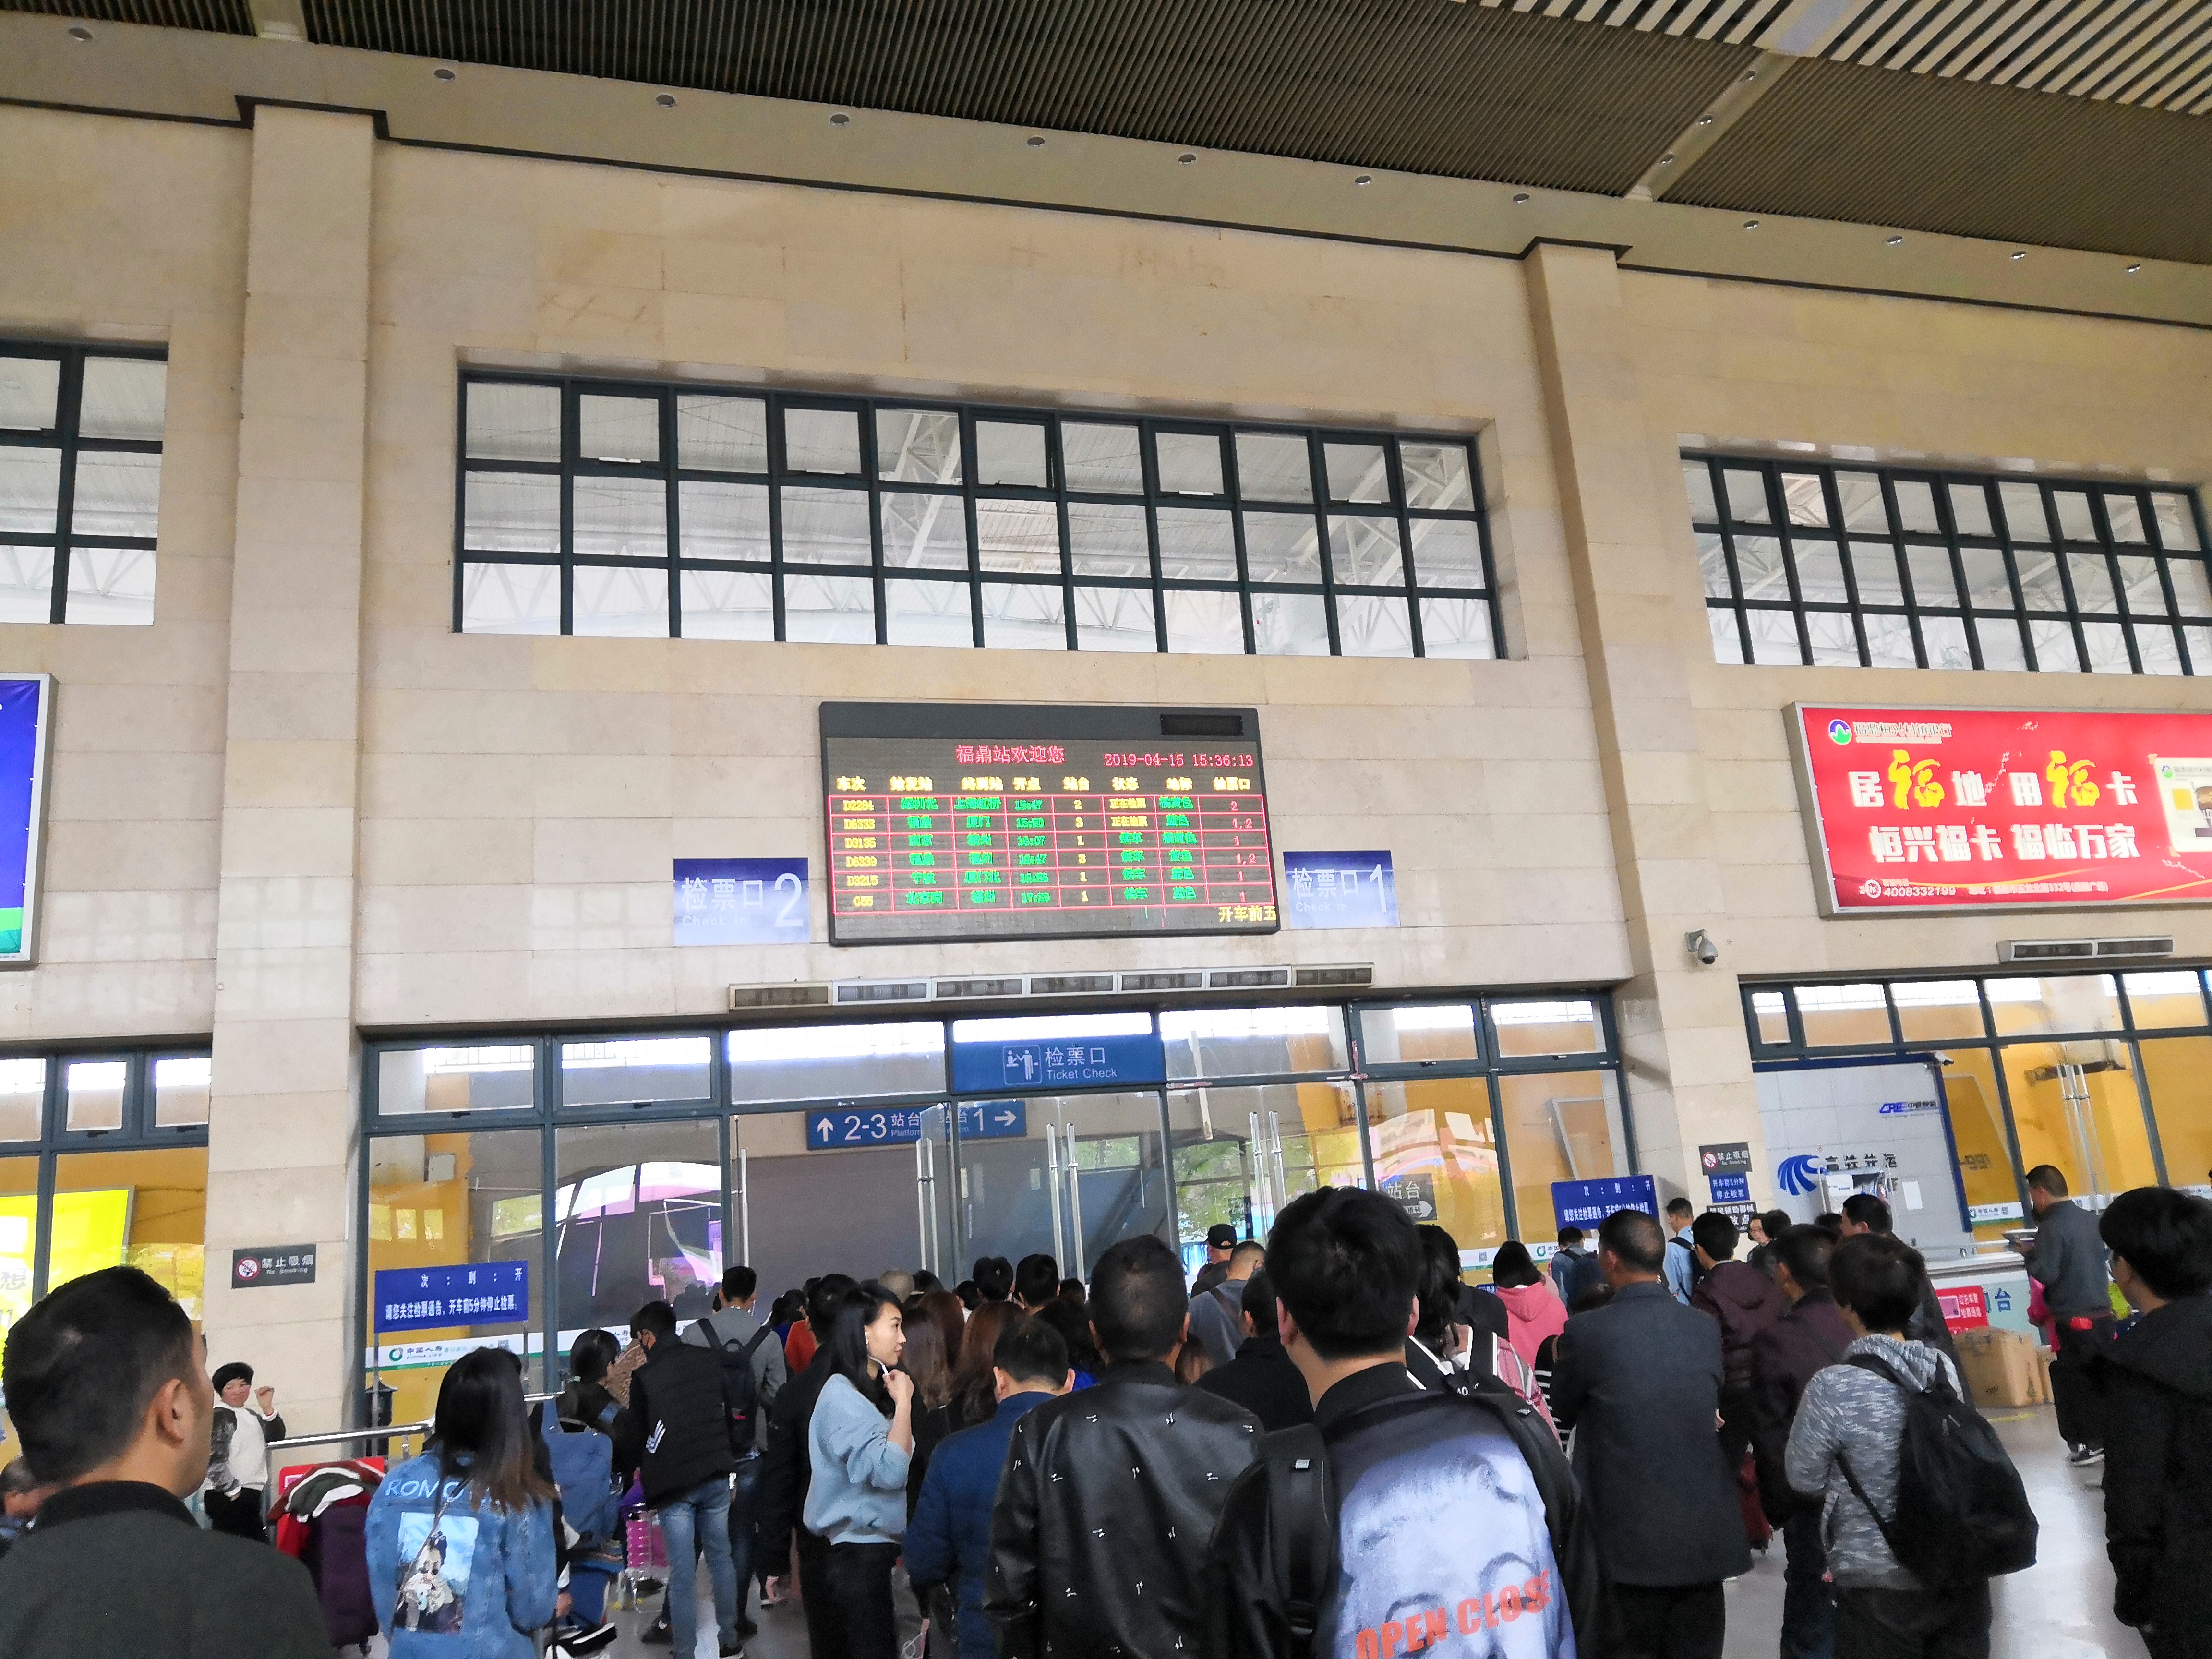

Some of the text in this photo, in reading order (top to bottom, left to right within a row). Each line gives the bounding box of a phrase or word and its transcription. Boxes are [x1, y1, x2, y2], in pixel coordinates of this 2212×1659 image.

[955, 745, 1065, 763] 福鼎站欢迎您
[1104, 753, 1254, 767] 2019-04-15 15:36:13
[1074, 800, 1082, 810] 2
[1230, 801, 1238, 811] 2
[1077, 835, 1084, 846] 1
[1234, 835, 1240, 846] 1
[1080, 871, 1087, 882] 1
[1237, 871, 1244, 882] 1
[1292, 867, 1358, 899] 检票口
[682, 877, 764, 911] 检票口
[1369, 863, 1387, 913] 1
[774, 872, 804, 927] 2
[1081, 891, 1089, 902] 1
[1239, 891, 1246, 902] 1
[1296, 902, 1330, 912] Check
[683, 915, 725, 926] Check
[1045, 1047, 1106, 1067] 检票口
[1047, 1068, 1118, 1080] Ticket Check
[844, 1114, 887, 1141] 2-3
[974, 1108, 984, 1132] 1
